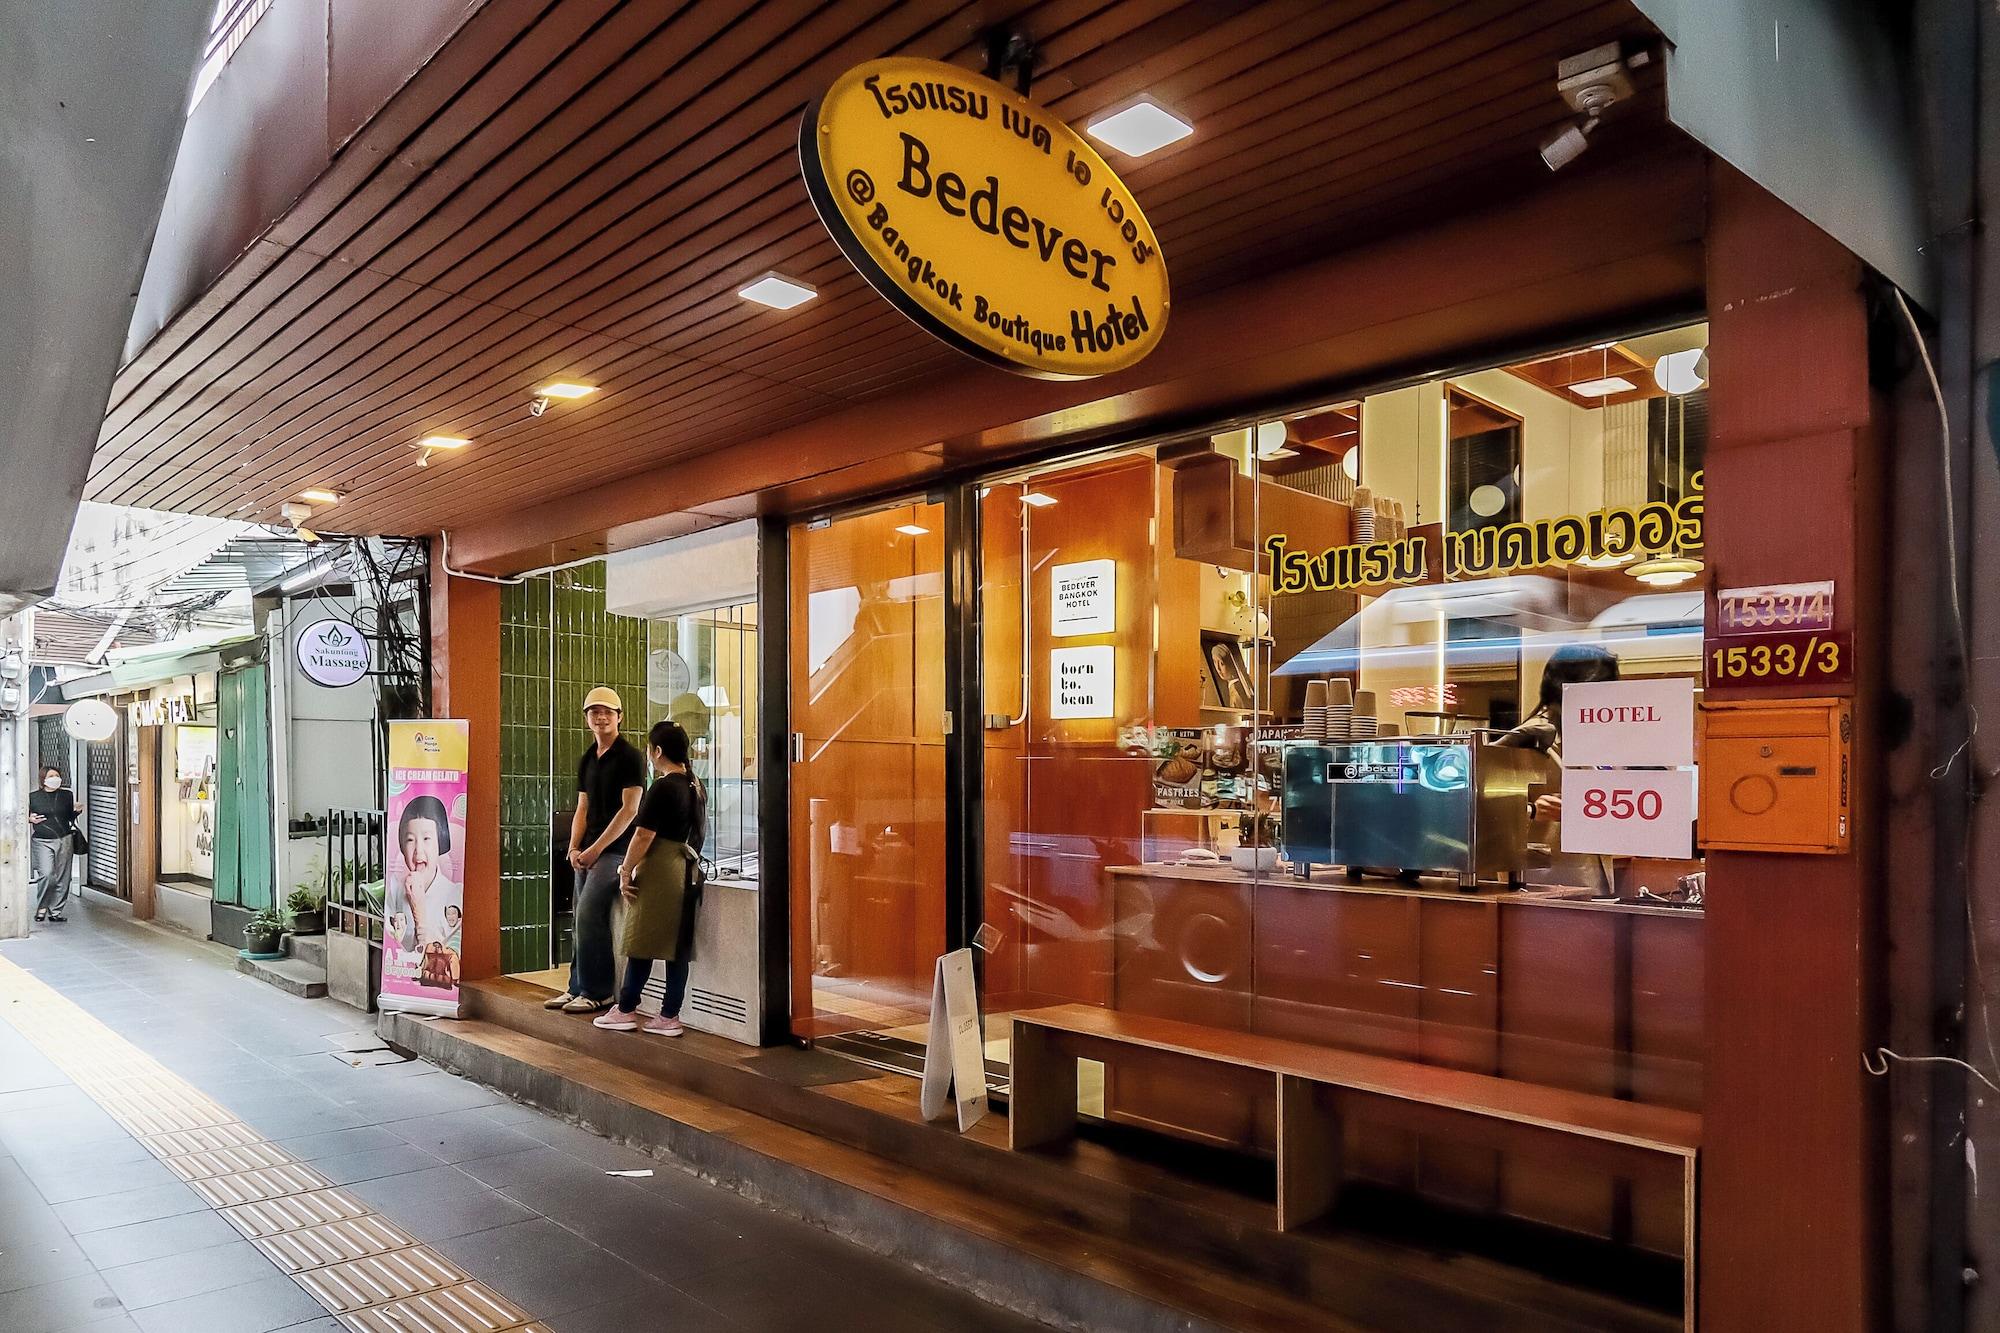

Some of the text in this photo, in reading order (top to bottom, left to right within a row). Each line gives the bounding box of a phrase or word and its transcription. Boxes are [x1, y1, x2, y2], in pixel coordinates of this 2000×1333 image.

[864, 74, 990, 120] โรงแรม
[897, 131, 1117, 293] Bedever
[973, 295, 1067, 355] Boutique
[1070, 295, 1149, 353] Hotel
[1266, 533, 1427, 595] โรงแรม
[1061, 580, 1096, 591] BEDEVER
[1058, 589, 1098, 601] BANGKOK
[1066, 599, 1090, 608] HOTEL
[1722, 591, 1826, 629] 1533/4
[310, 655, 366, 671] Massage
[1712, 636, 1840, 678] 1533/3
[1061, 662, 1095, 675] born
[1061, 692, 1094, 705] bean
[1579, 706, 1662, 724] HOTEL
[395, 770, 459, 781] ICE CREAM GELATO
[1156, 787, 1200, 798] PASTRIES
[1582, 788, 1663, 821] 850
